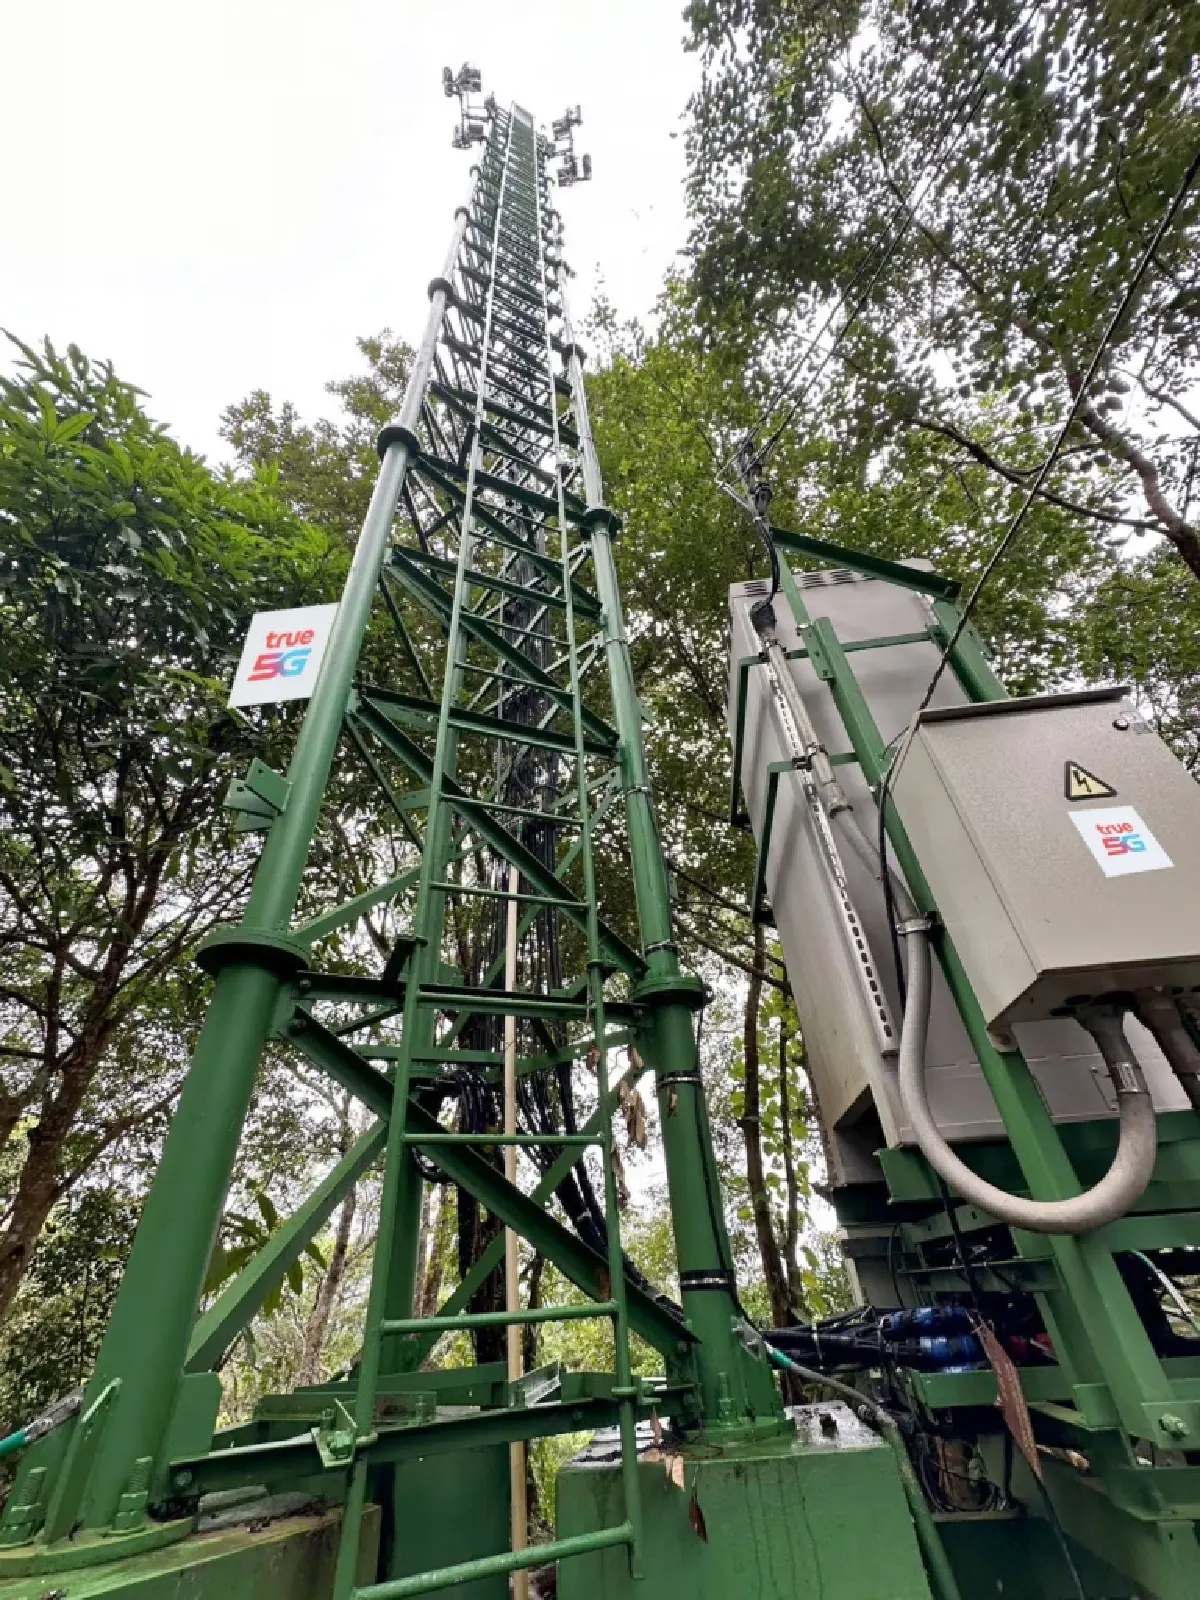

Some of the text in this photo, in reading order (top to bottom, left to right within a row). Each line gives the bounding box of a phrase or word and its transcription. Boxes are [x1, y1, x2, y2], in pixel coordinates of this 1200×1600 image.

[266, 630, 314, 648] true
[248, 648, 312, 681] 5G
[1096, 823, 1134, 834] true
[1102, 834, 1147, 856] 5G
